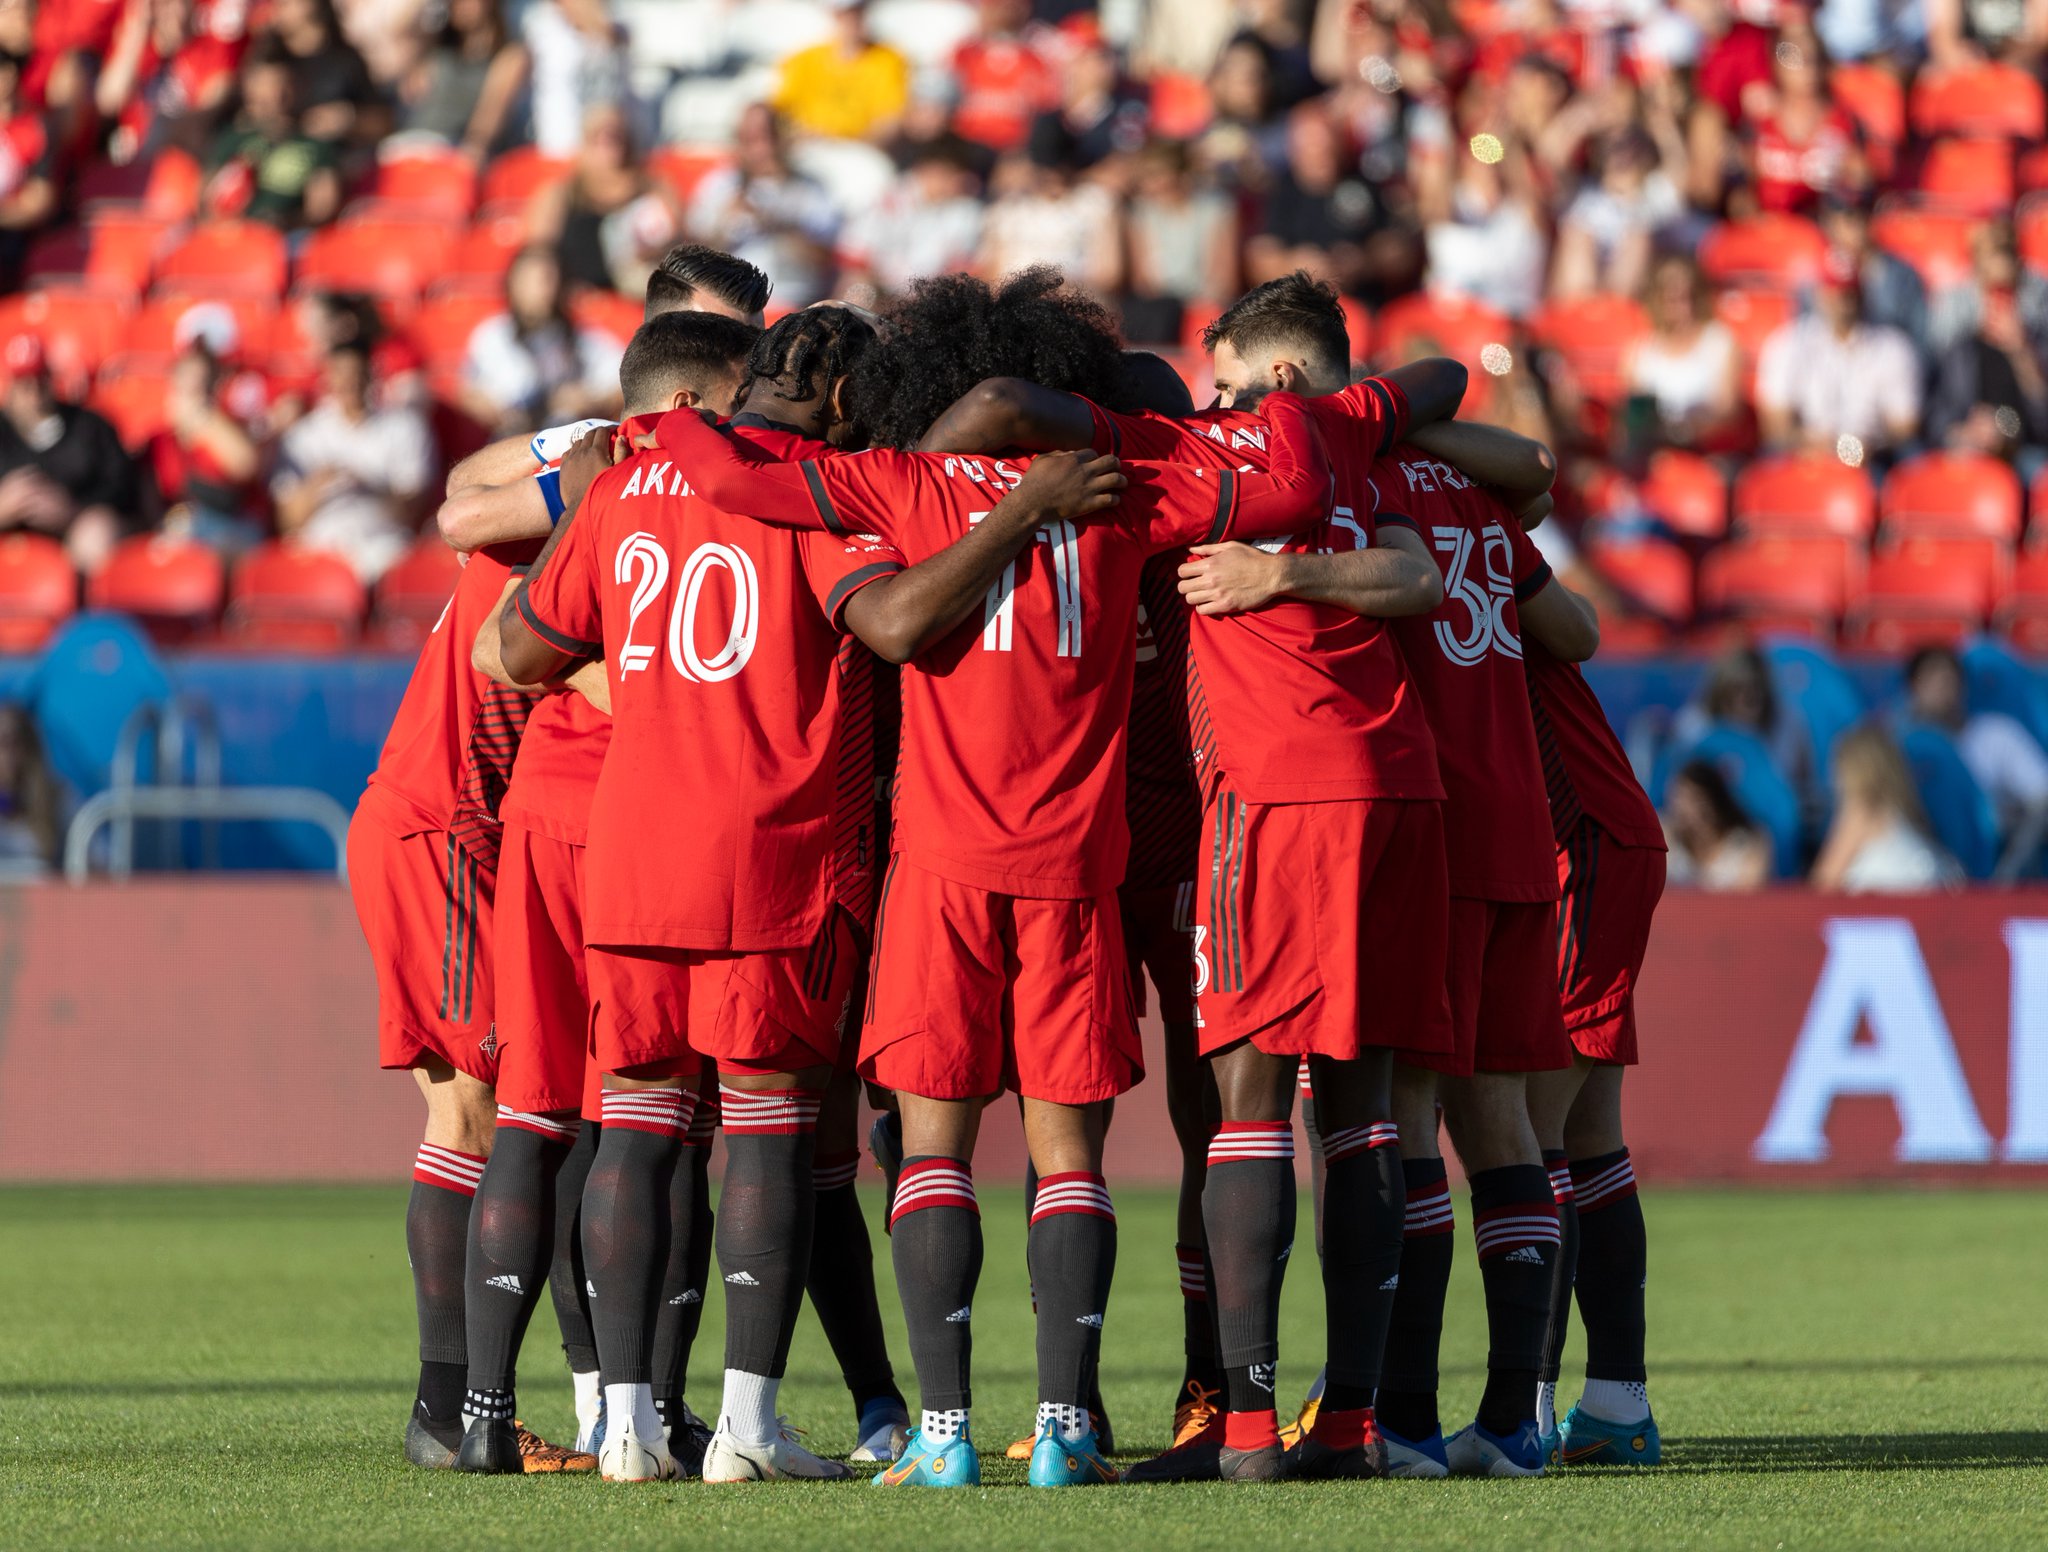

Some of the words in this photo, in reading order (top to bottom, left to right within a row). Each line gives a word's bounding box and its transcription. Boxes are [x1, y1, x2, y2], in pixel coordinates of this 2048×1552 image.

[614, 530, 760, 684] 20
[1431, 519, 1524, 667] 38
[486, 1279, 525, 1295] adidas
